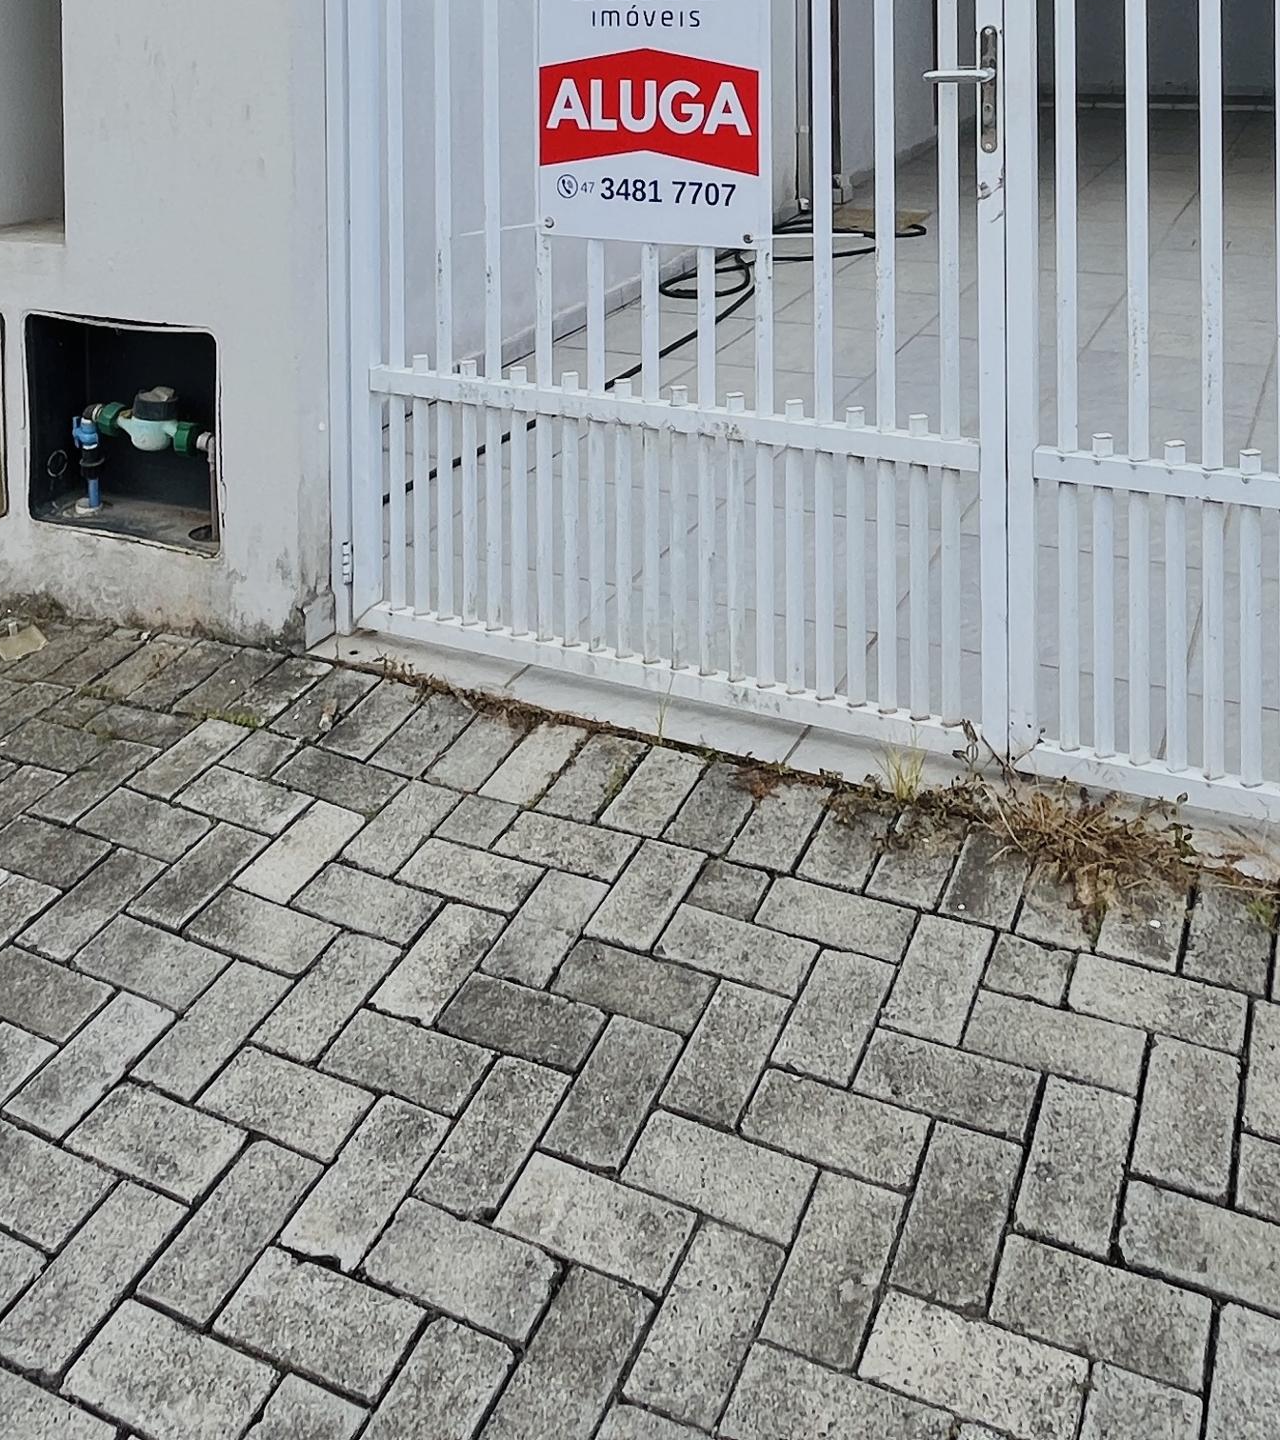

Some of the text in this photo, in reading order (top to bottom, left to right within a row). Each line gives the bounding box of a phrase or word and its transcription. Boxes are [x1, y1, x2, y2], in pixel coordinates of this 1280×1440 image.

[592, 4, 701, 28] imóveis
[546, 78, 752, 136] ALUGA
[580, 177, 736, 206] 47 3481 7707
